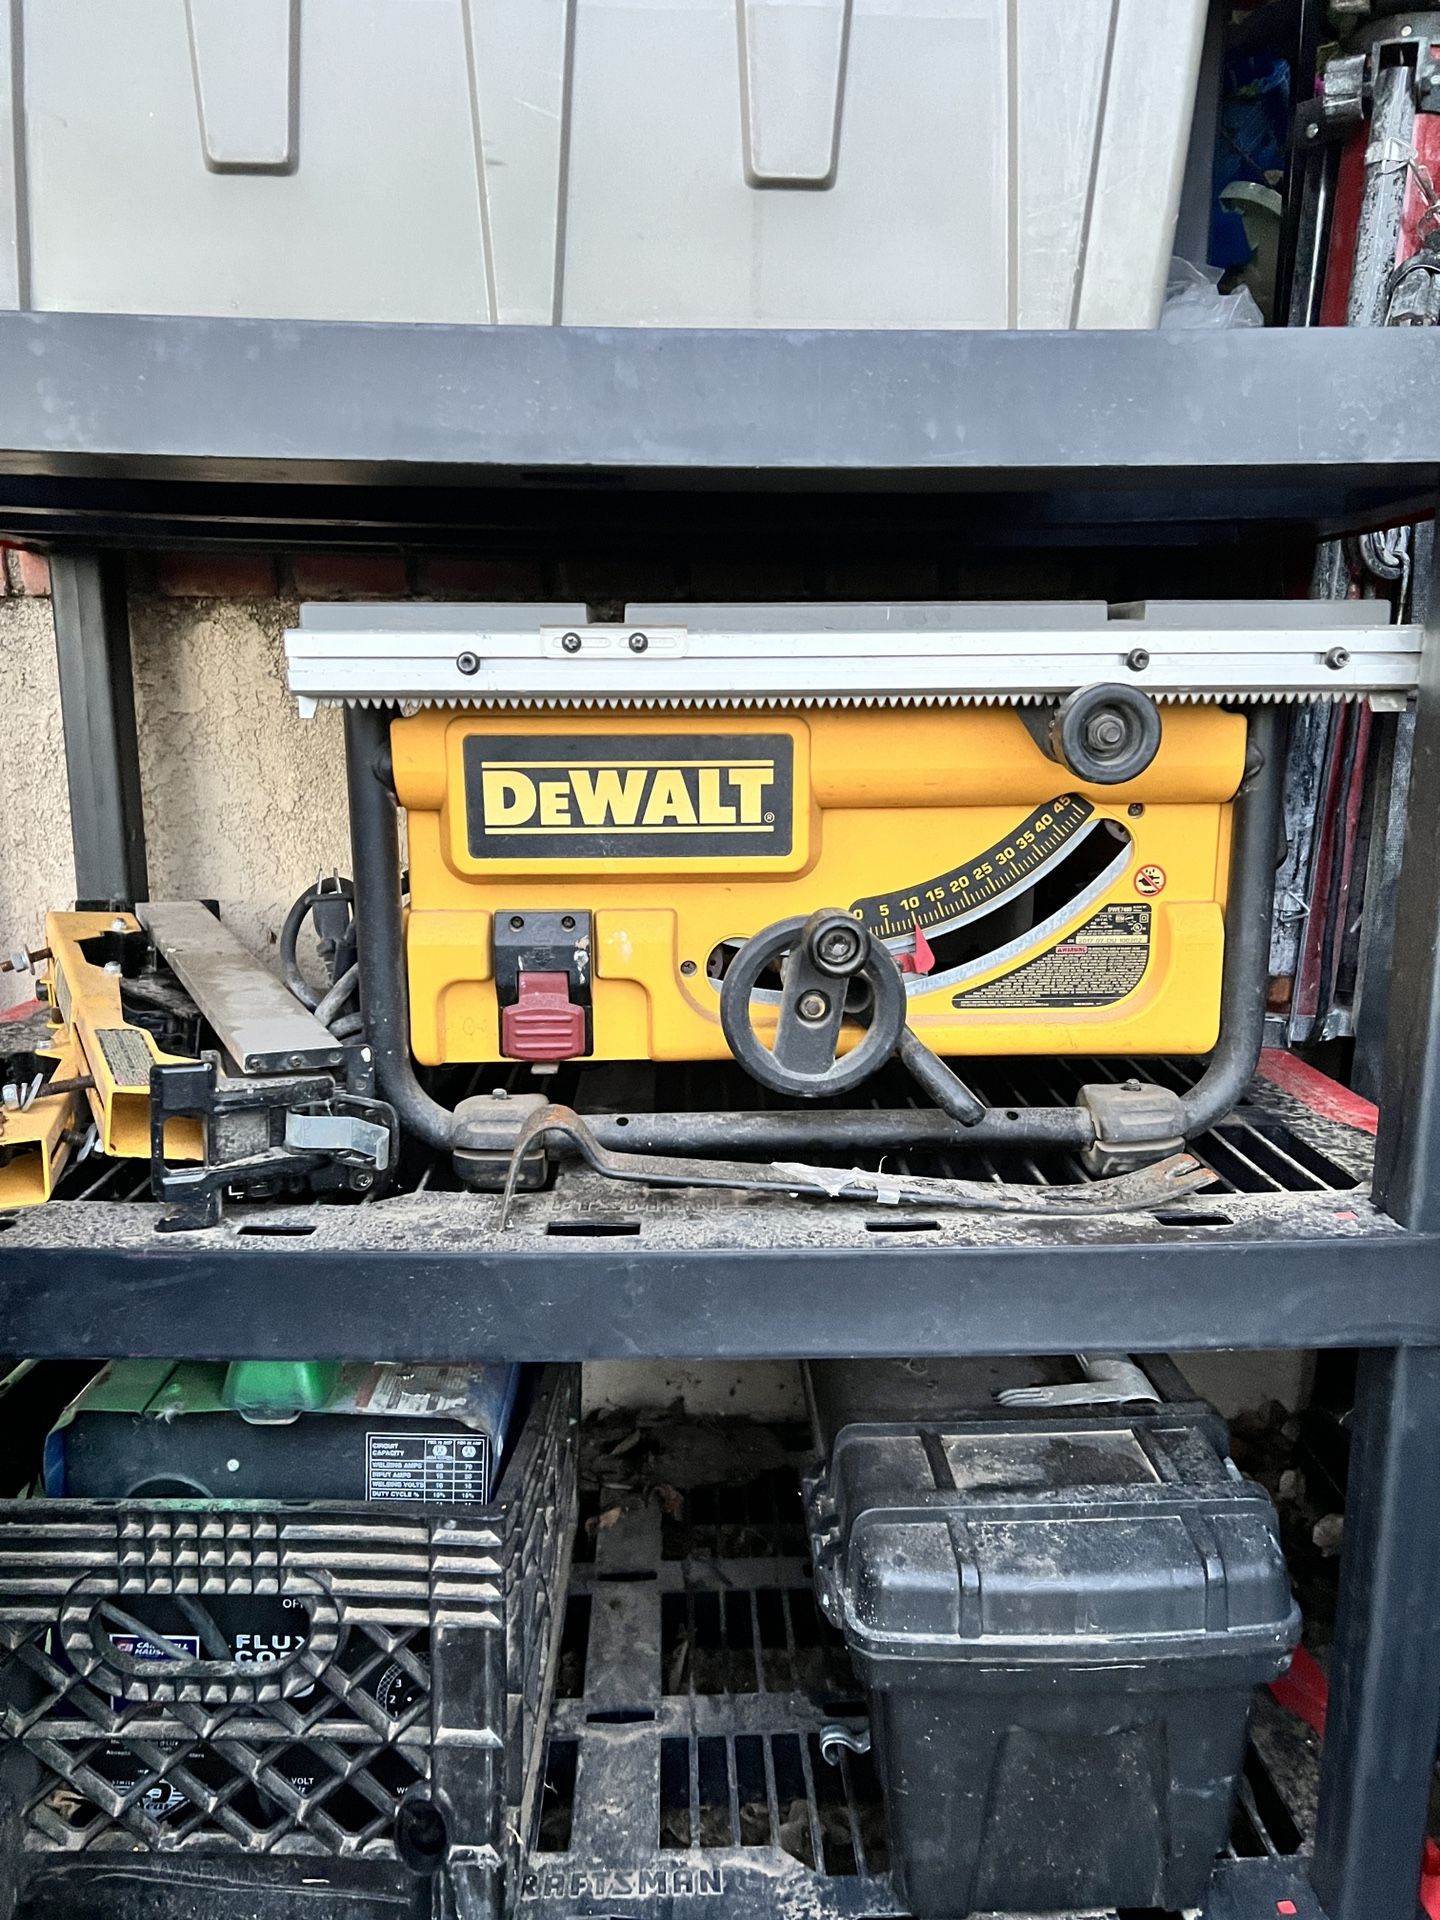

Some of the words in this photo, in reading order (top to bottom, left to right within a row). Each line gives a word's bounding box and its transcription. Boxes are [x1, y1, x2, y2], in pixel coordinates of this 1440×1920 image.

[853, 909, 864, 920] 0
[879, 904, 890, 916] 5
[900, 896, 920, 910] 10
[925, 887, 945, 902] 15
[949, 875, 970, 893] 20
[972, 862, 993, 880] 25
[995, 847, 1016, 865] 30
[1016, 830, 1035, 850] 35
[1035, 813, 1054, 833] 40
[1053, 796, 1071, 814] 45
[403, 1481, 424, 1489] VOLTS
[282, 1598, 303, 1609] OF
[234, 1650, 292, 1663] CO
[395, 1679, 402, 1688] 3
[389, 1695, 396, 1704] 2
[291, 1777, 315, 1785] VOLT
[520, 1868, 724, 1899] RAFTSMAN
